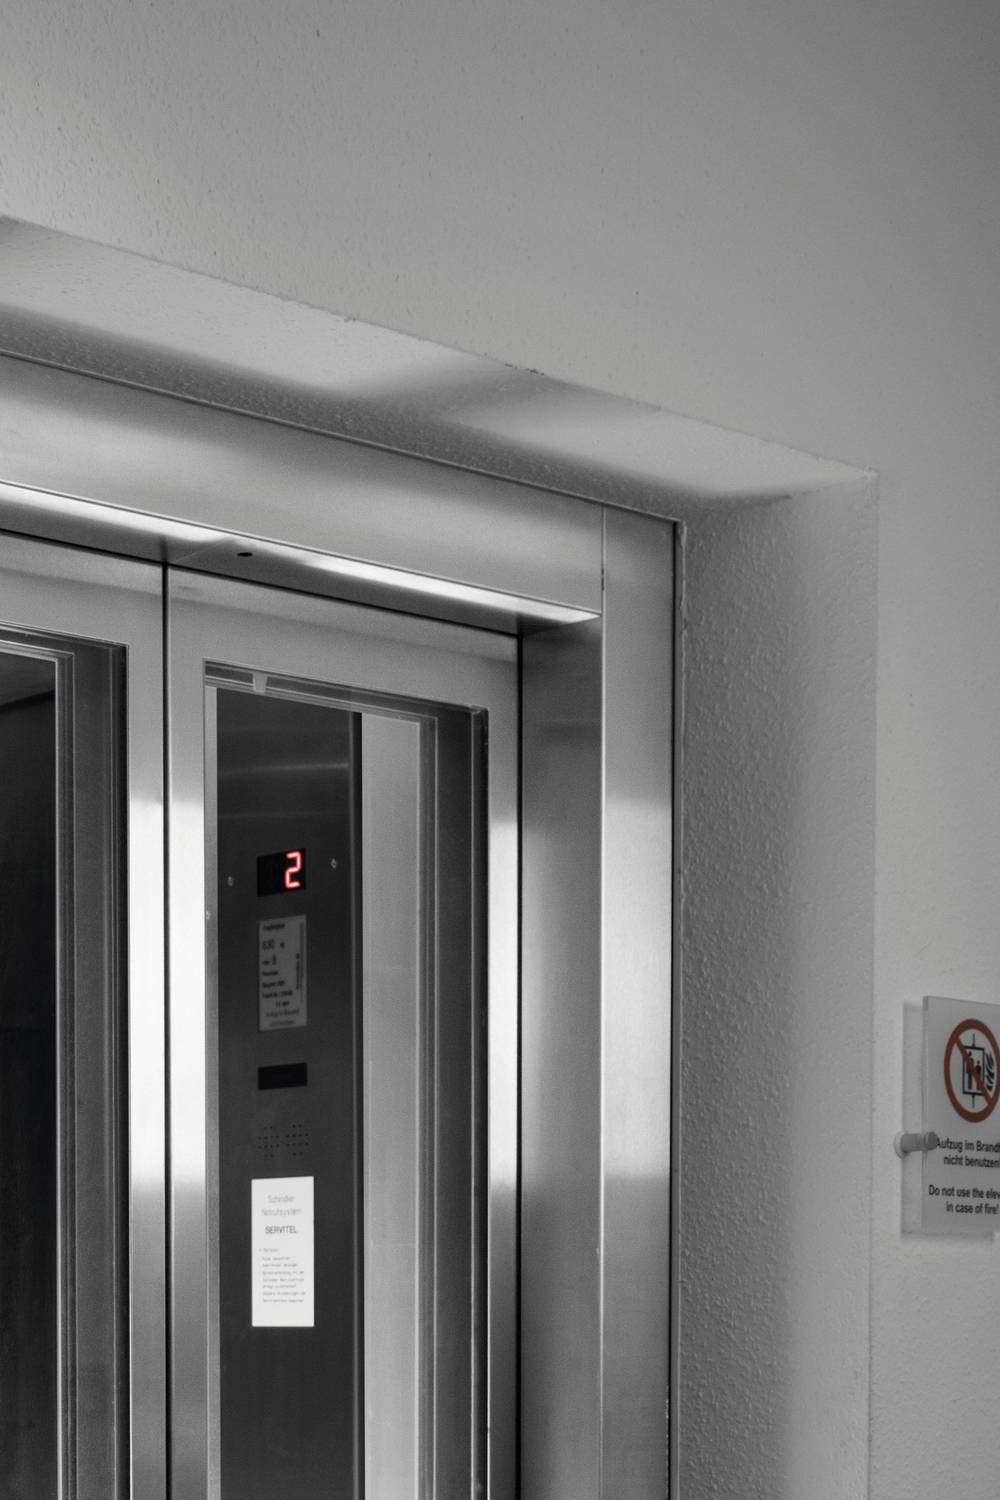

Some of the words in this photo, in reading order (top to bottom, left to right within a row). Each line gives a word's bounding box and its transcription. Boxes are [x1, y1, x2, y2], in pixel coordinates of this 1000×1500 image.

[285, 850, 302, 889] 2
[943, 1154, 963, 1166] nicht
[928, 1184, 940, 1196] Do
[942, 1187, 955, 1197] not
[956, 1188, 970, 1198] use
[972, 1187, 984, 1199] the
[946, 1201, 954, 1212] in
[955, 1203, 973, 1213] case
[975, 1203, 984, 1214] of
[265, 1225, 297, 1235] SERVITEL
